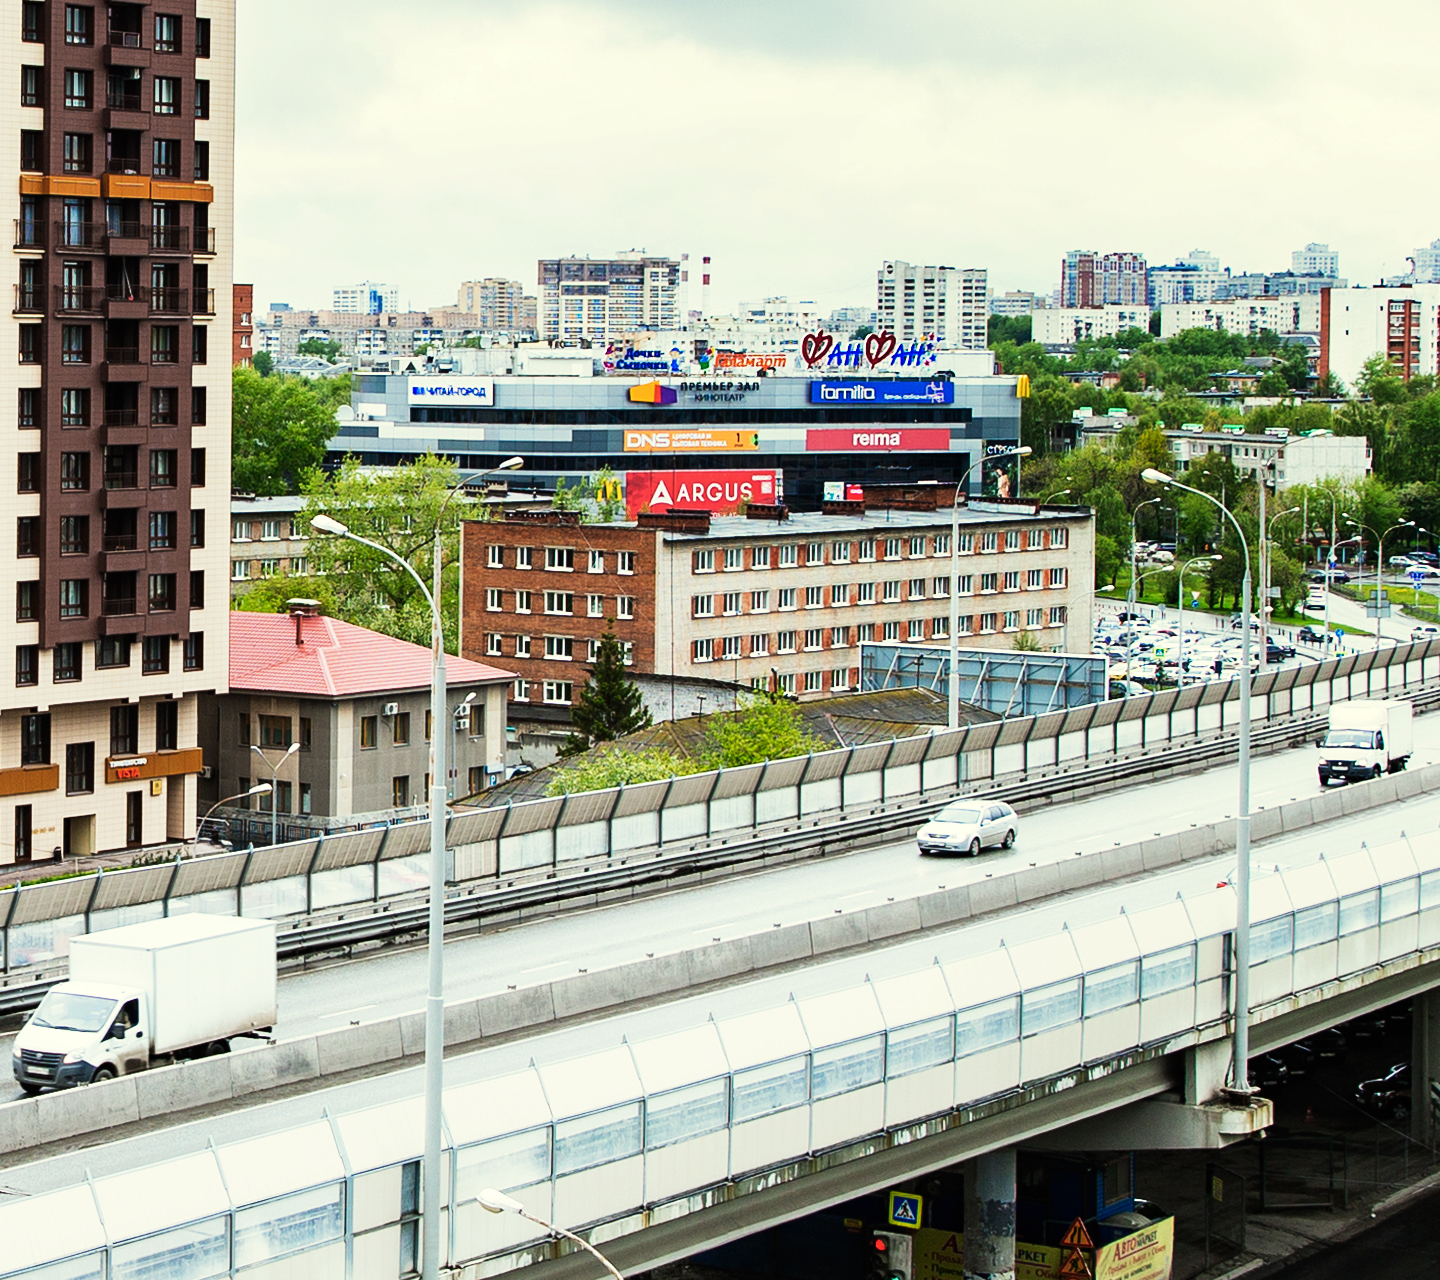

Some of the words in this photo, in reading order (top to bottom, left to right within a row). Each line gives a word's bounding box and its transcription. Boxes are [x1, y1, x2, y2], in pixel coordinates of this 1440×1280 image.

[426, 384, 487, 398] ЧИТАЙ-ГОРОД
[680, 381, 734, 392] ПРЕМЬЕР
[738, 381, 760, 391] ЗАЛ
[820, 384, 876, 400] familia
[694, 393, 745, 402] КИНОТЕАТР
[627, 433, 671, 448] DNS
[852, 432, 901, 446] reima
[676, 483, 753, 502] ARGUS
